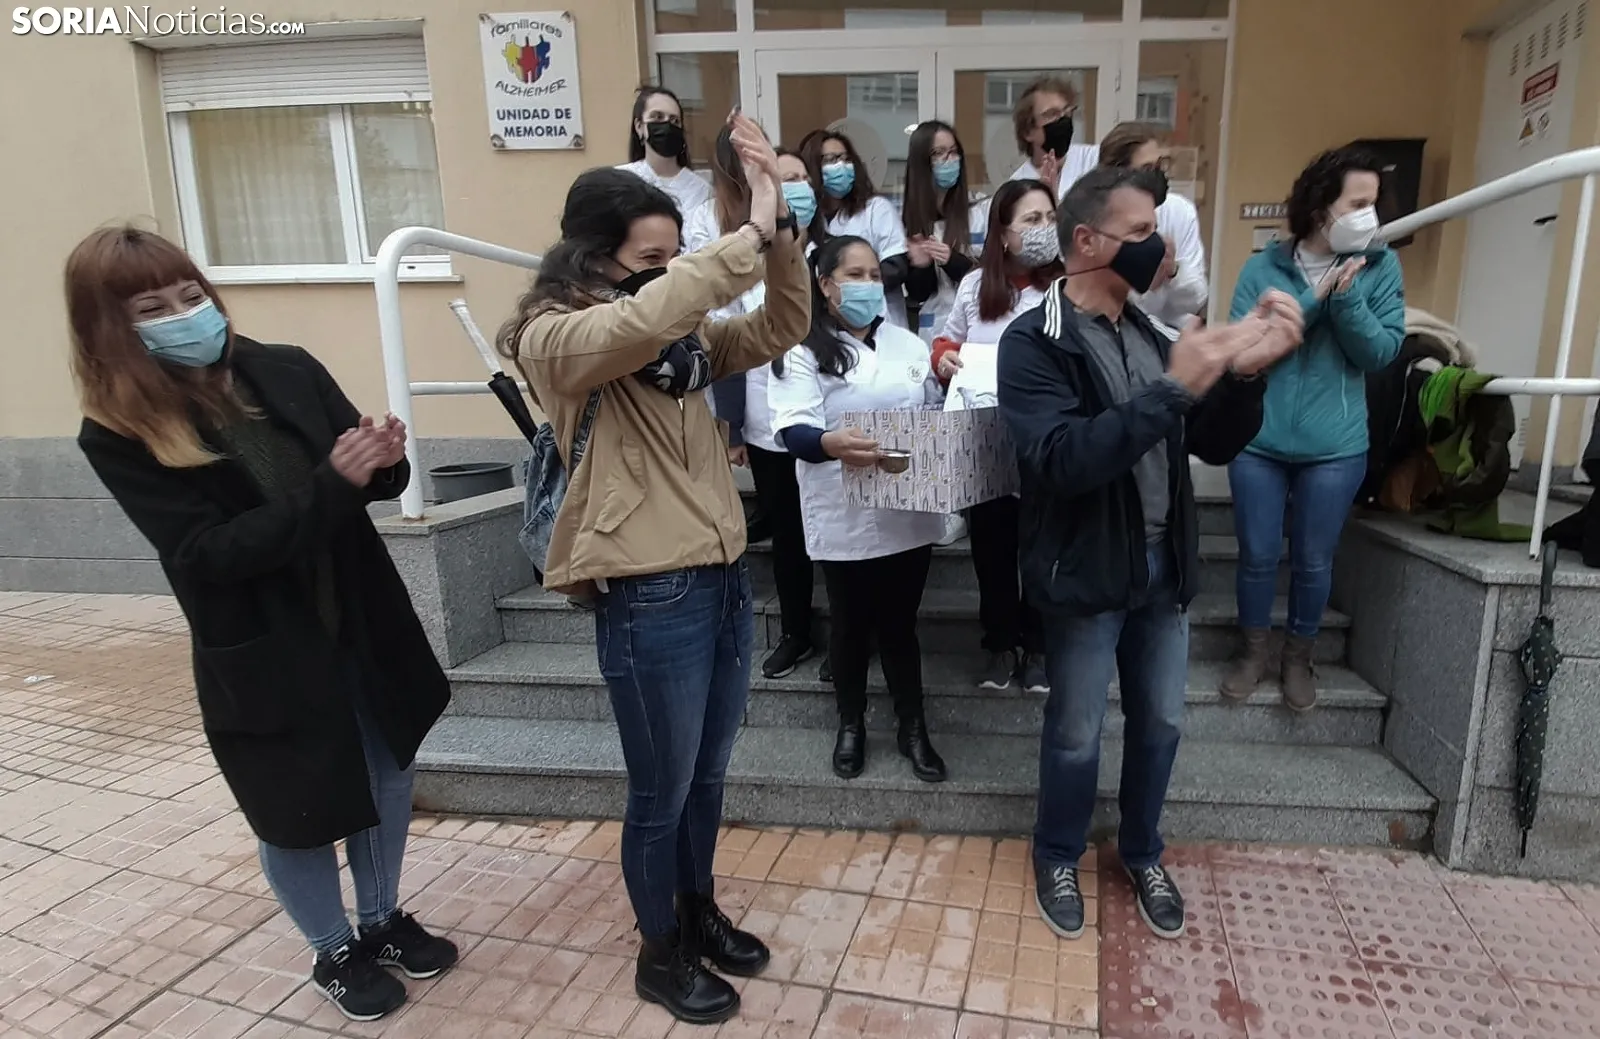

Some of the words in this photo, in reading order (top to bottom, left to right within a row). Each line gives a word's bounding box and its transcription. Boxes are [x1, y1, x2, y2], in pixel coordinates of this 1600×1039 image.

[495, 78, 568, 97] ALZHEIMER
[496, 108, 550, 120] UNIDAD
[554, 107, 572, 120] DE
[503, 125, 568, 138] MEMORIA
[325, 978, 347, 1001] N
